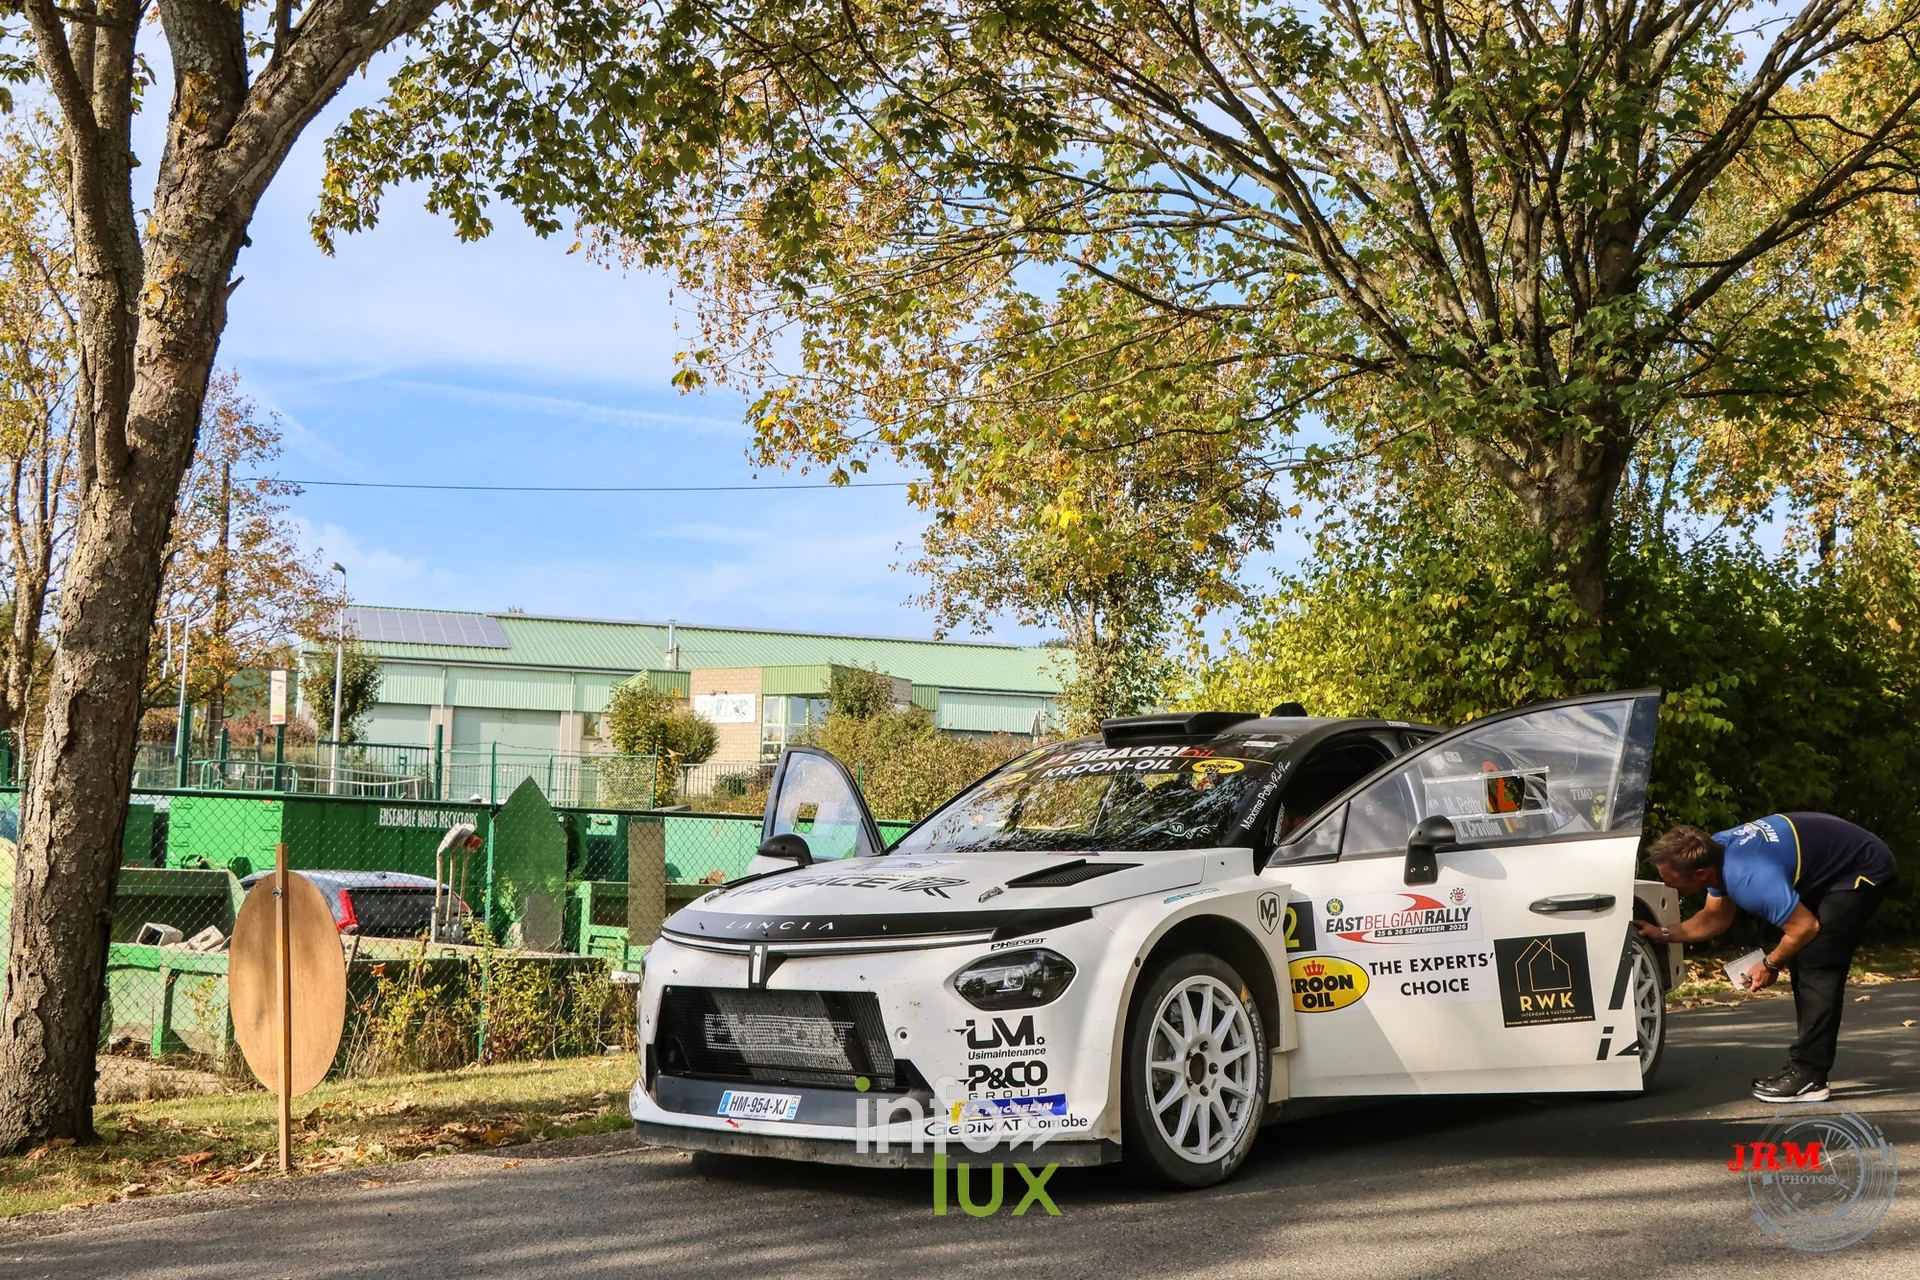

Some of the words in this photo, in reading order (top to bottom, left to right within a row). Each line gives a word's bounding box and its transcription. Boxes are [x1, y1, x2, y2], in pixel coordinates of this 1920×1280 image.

[1061, 745, 1191, 764] PIRAGRI
[1040, 759, 1173, 778] KROON-OIL
[1570, 788, 1593, 801] TIMO
[1240, 800, 1265, 830] Maxime
[1257, 781, 1278, 801] Potty
[1456, 796, 1483, 814] Potty
[379, 807, 416, 827] ENSEMBLE
[417, 809, 438, 828] NOUS
[725, 921, 834, 931] LANCIA
[1284, 907, 1299, 948] 2
[1325, 916, 1364, 933] EAST
[1364, 911, 1424, 930] BELGIAN
[1424, 907, 1472, 925] RALLY
[1404, 925, 1446, 934] SEPTEMBER
[1369, 959, 1403, 976] THE
[1400, 978, 1470, 997] CHOICE
[1302, 992, 1335, 1009] OIL
[1519, 991, 1575, 1012] RWK
[968, 1047, 1047, 1060] Usimaintenance
[1250, 1012, 1264, 1090] MICHELIN
[968, 1060, 1048, 1091] P&CO
[968, 1088, 1048, 1100] GROUP
[729, 1095, 788, 1115] HM-954-XJ
[985, 1102, 1054, 1115] MICHELIN
